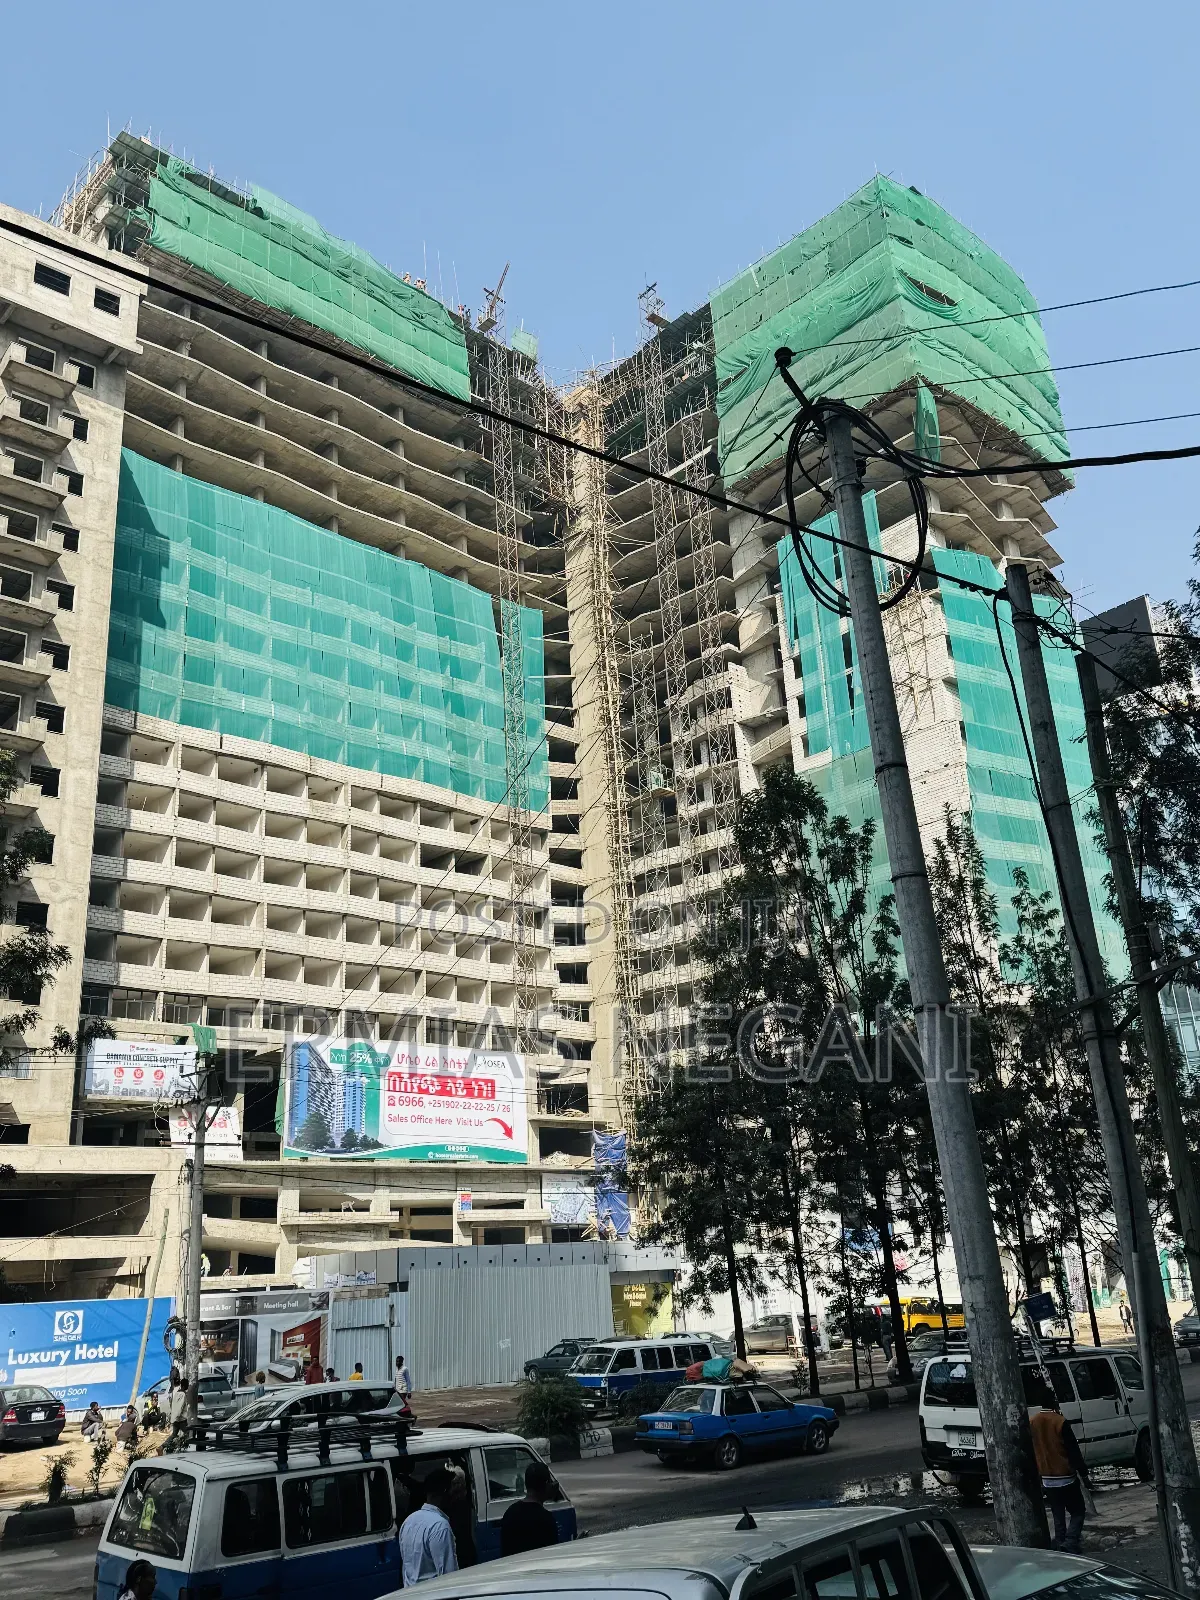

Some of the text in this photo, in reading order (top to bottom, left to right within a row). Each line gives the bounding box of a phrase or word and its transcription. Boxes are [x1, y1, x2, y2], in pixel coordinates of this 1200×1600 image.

[349, 1051, 373, 1064] 25%
[428, 1100, 495, 1111] +251902-22-22-25
[502, 1104, 511, 1113] 26
[387, 1114, 484, 1127] Sales Office Here Visit Us
[263, 1300, 299, 1310] Meeting hall
[8, 1340, 119, 1366] Luxury Hotel
[67, 1387, 88, 1396] Soon
